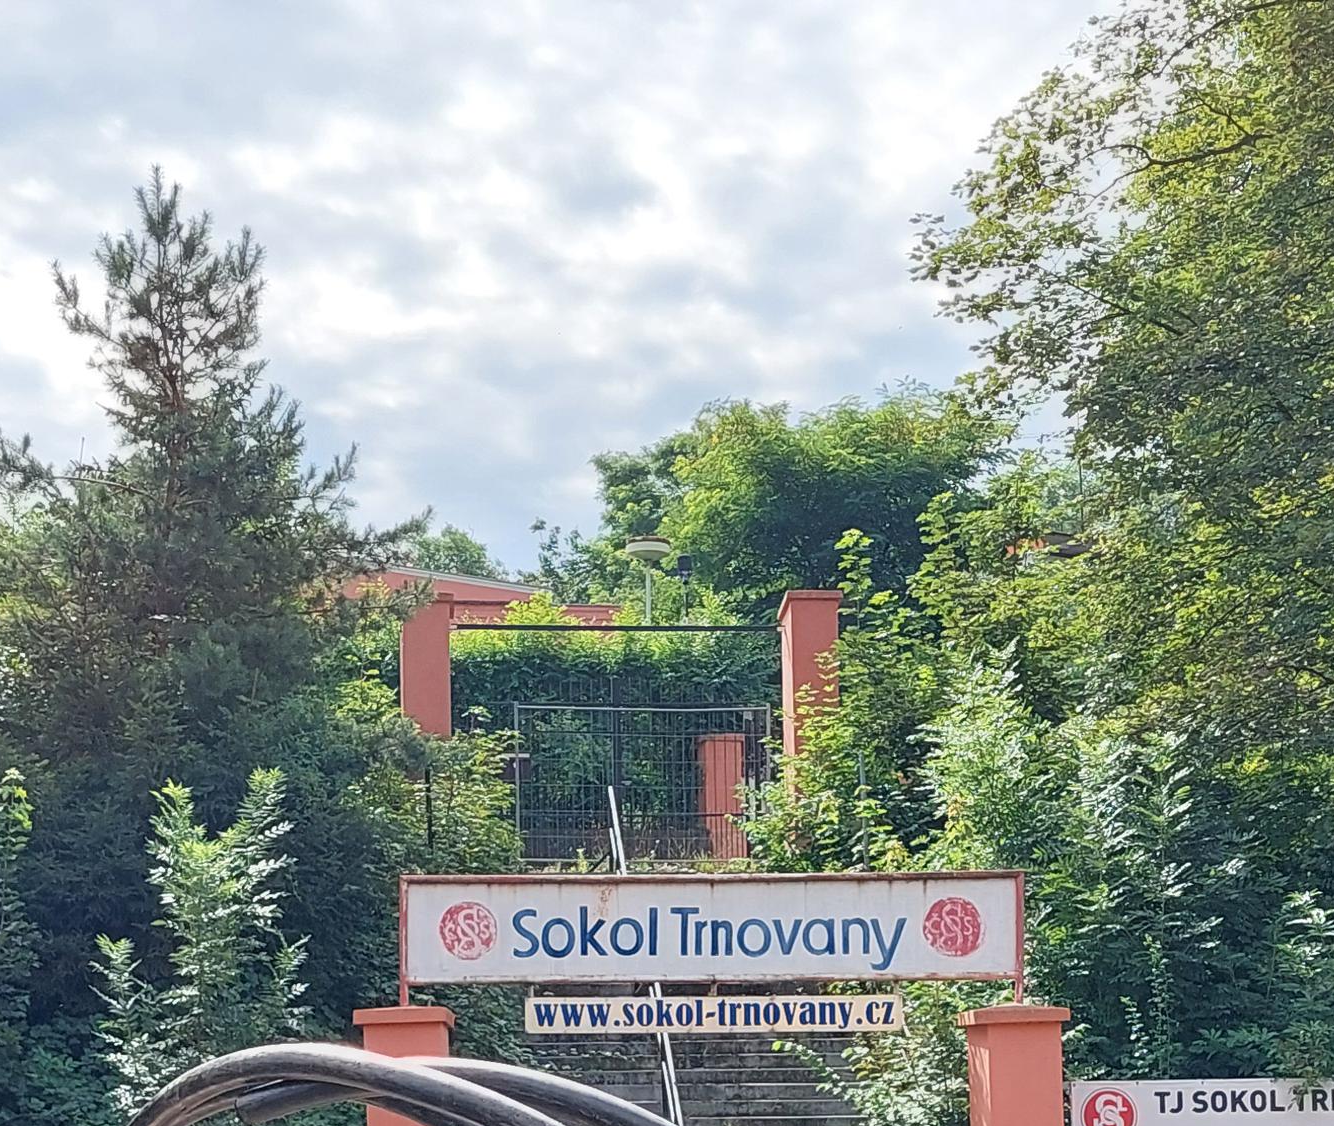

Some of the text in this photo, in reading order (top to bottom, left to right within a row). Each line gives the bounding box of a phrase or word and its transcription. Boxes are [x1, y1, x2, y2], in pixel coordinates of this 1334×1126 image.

[512, 906, 658, 958] Sokol
[670, 907, 907, 971] Trnovany
[533, 1000, 895, 1029] www.sokol-trnovany.cz
[1154, 1091, 1183, 1114] TJ
[1192, 1090, 1286, 1113] SOKOL
